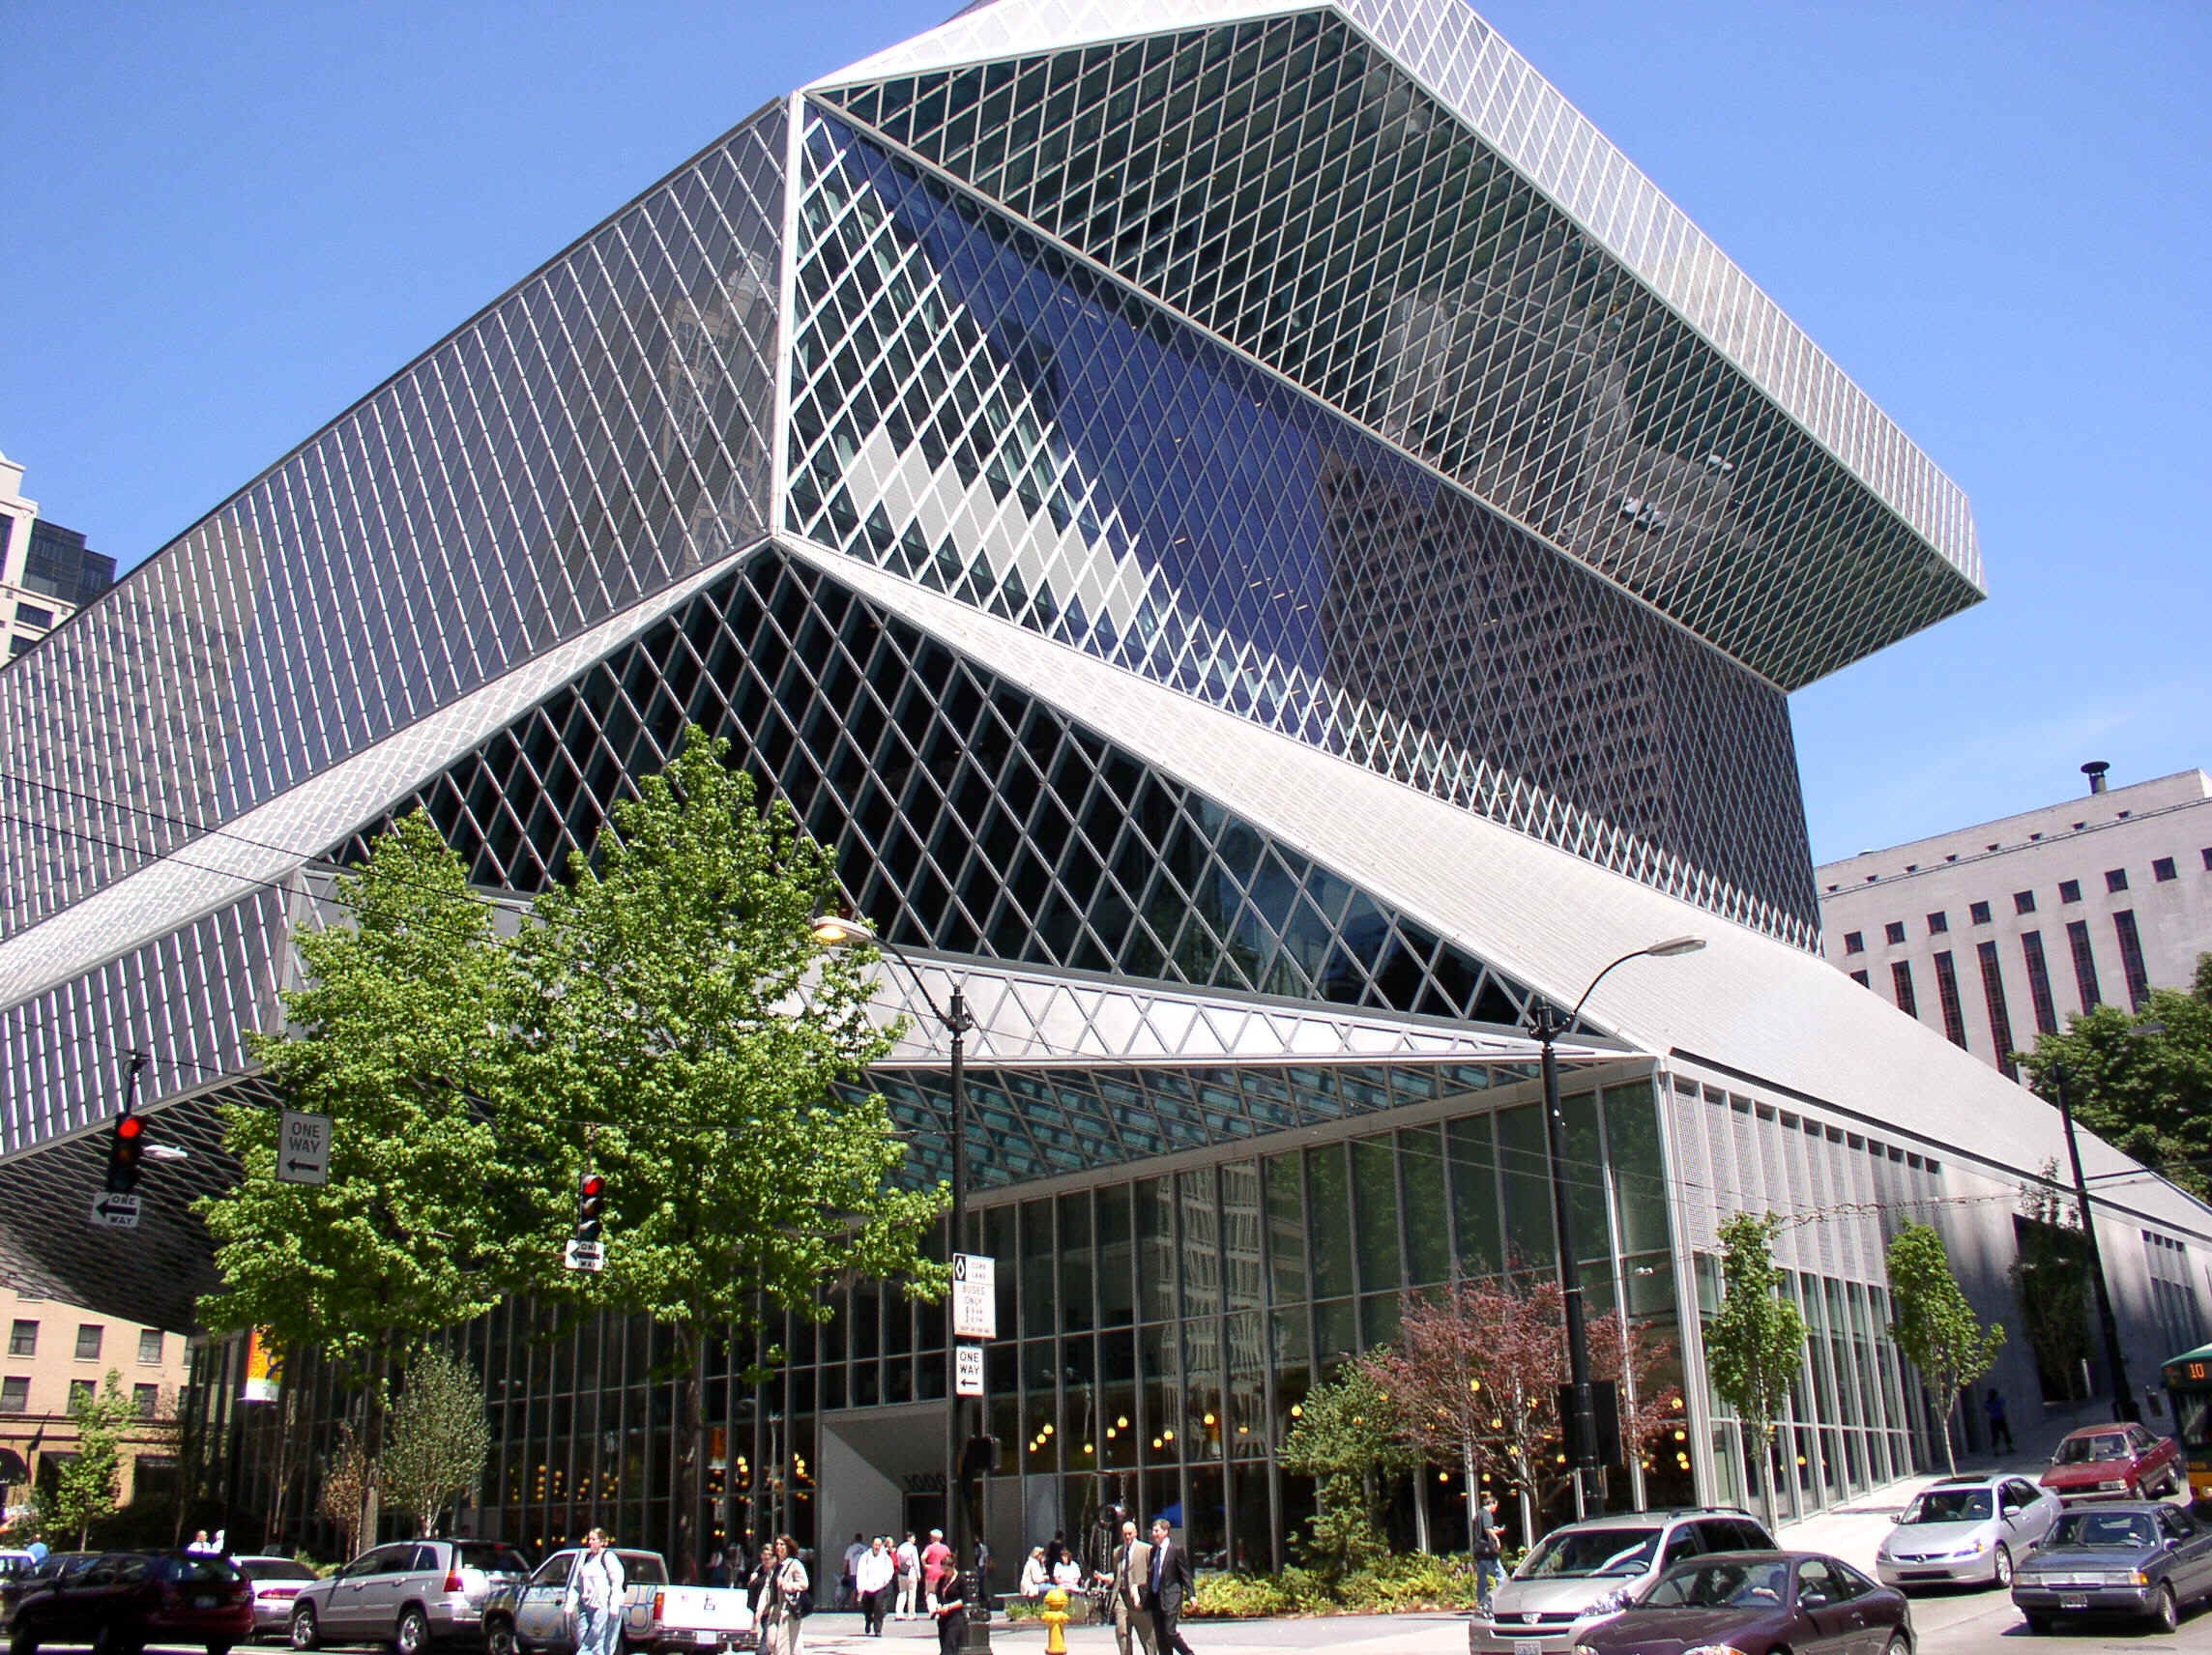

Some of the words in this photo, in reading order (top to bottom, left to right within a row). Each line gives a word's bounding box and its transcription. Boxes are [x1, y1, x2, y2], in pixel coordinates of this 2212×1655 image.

[292, 1121, 320, 1138] ONE
[289, 1137, 320, 1152] WAY
[112, 1195, 135, 1205] ONE
[110, 1215, 132, 1225] WAY
[963, 1285, 985, 1294] BUSES
[965, 1296, 982, 1306] ONLY
[959, 1351, 979, 1363] ONE
[959, 1363, 979, 1376] WAY
[2189, 1362, 2204, 1379] 10
